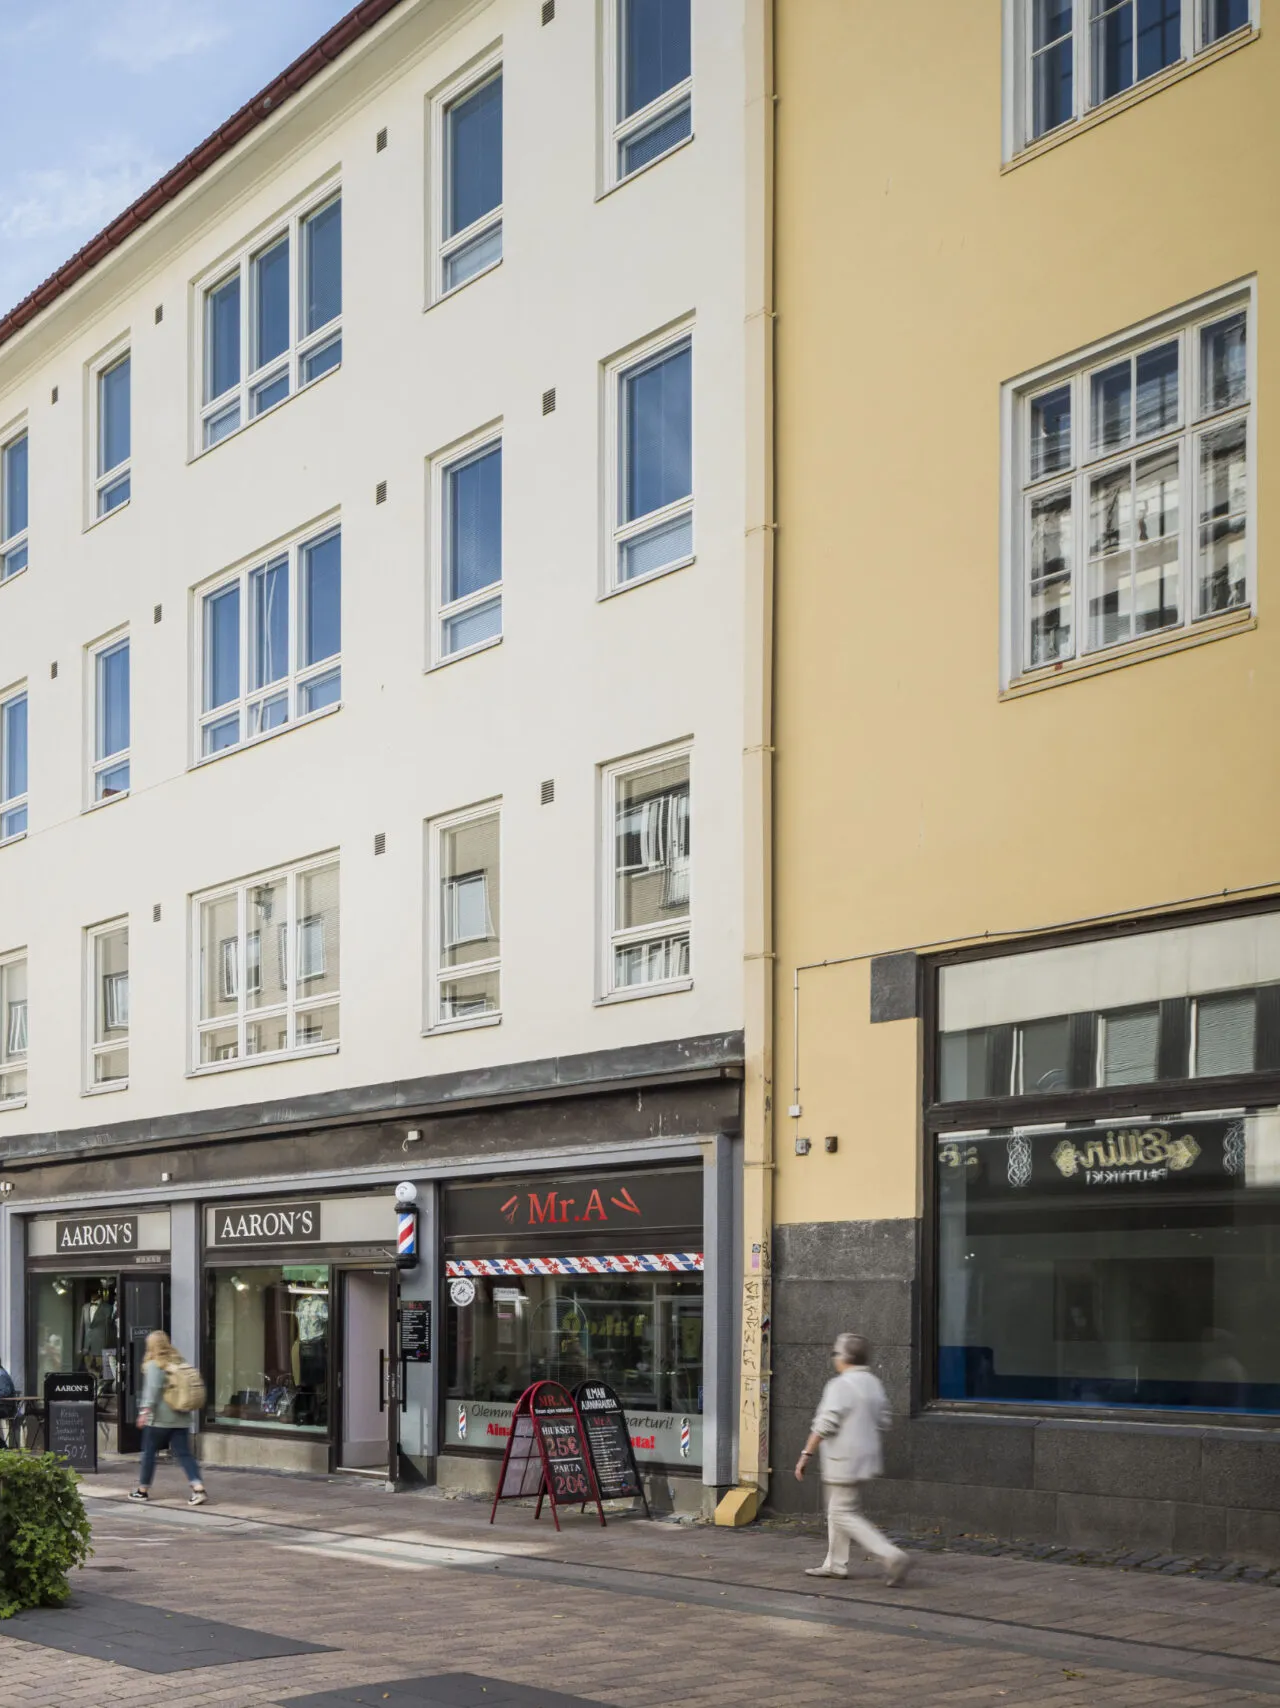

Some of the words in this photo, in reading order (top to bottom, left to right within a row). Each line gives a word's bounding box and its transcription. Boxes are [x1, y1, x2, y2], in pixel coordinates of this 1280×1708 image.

[528, 1188, 608, 1225] Mr.A
[585, 1387, 607, 1400] ILMAN
[471, 1404, 512, 1418] Olemm
[541, 1425, 576, 1435] HIUKSET
[547, 1436, 579, 1457] 25€
[553, 1464, 581, 1473] PARTA
[555, 1473, 588, 1494] 20€
